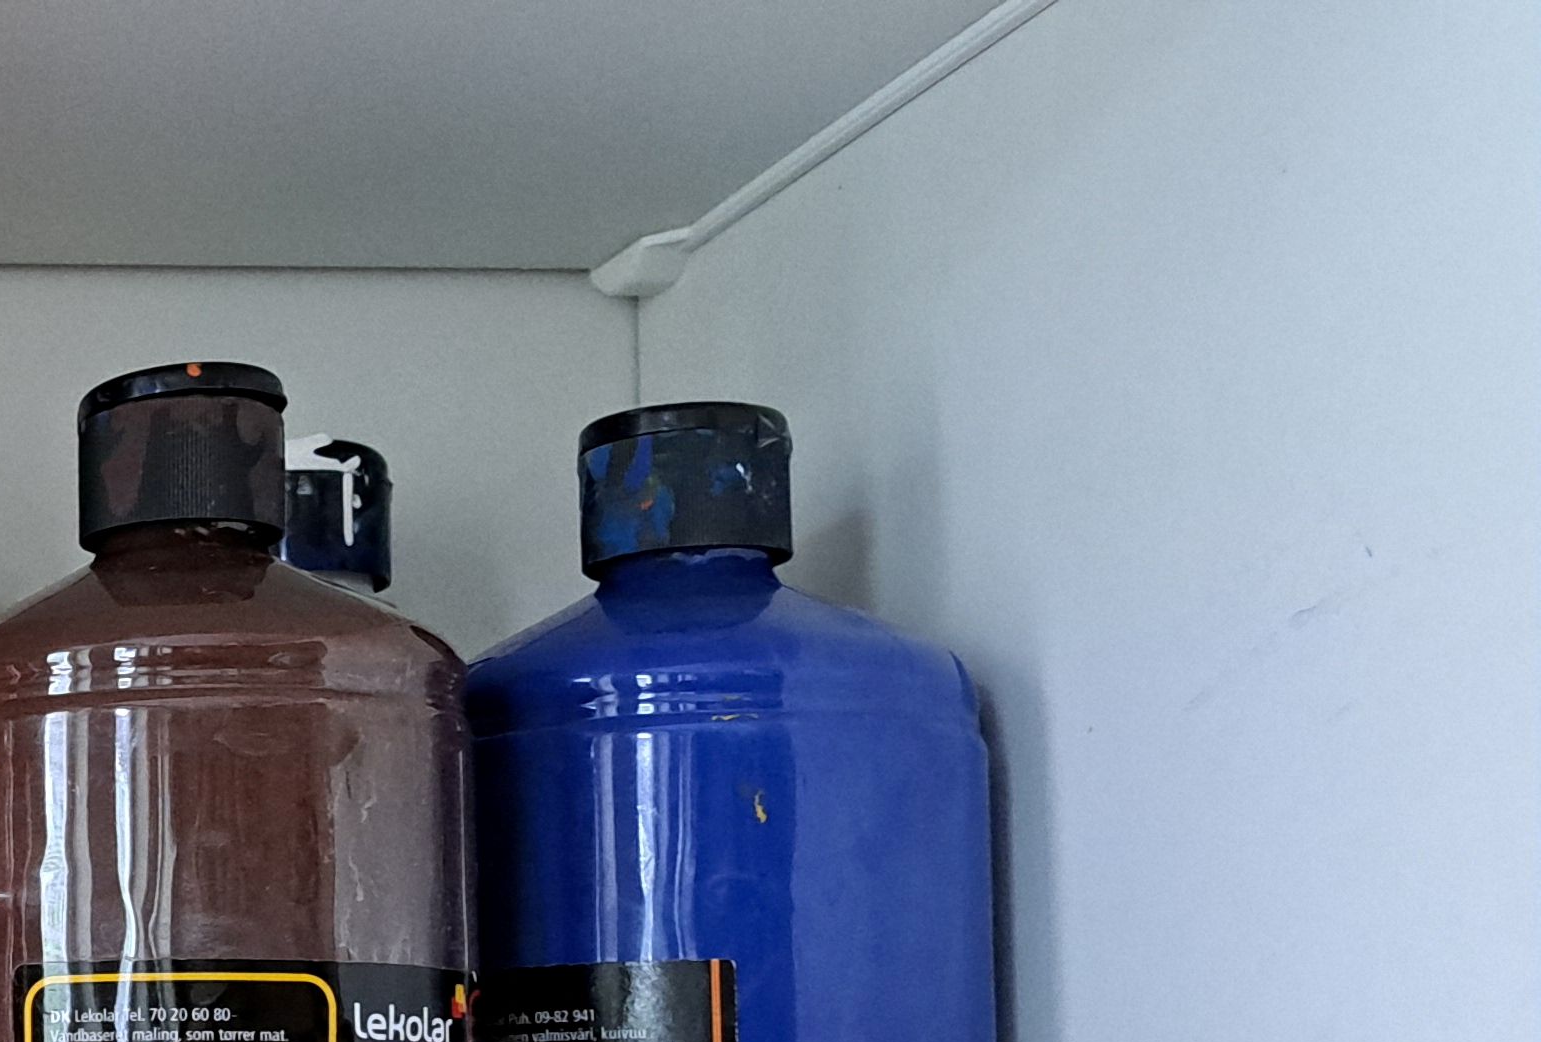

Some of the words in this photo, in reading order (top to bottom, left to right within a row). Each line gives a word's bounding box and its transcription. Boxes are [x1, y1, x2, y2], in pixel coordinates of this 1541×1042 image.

[51, 1010, 70, 1023] DK
[150, 1008, 166, 1021] 70
[170, 1008, 187, 1021] 20
[192, 1008, 209, 1022] 60
[534, 1011, 568, 1024] 09-82
[573, 1009, 595, 1022] 941
[51, 1028, 129, 1042] Vandbaseret
[186, 1030, 214, 1041] som
[219, 1029, 255, 1041] tørrer
[260, 1030, 289, 1041] mat.
[532, 1028, 597, 1042] valmisväri,
[601, 1026, 647, 1040] kuivuu
